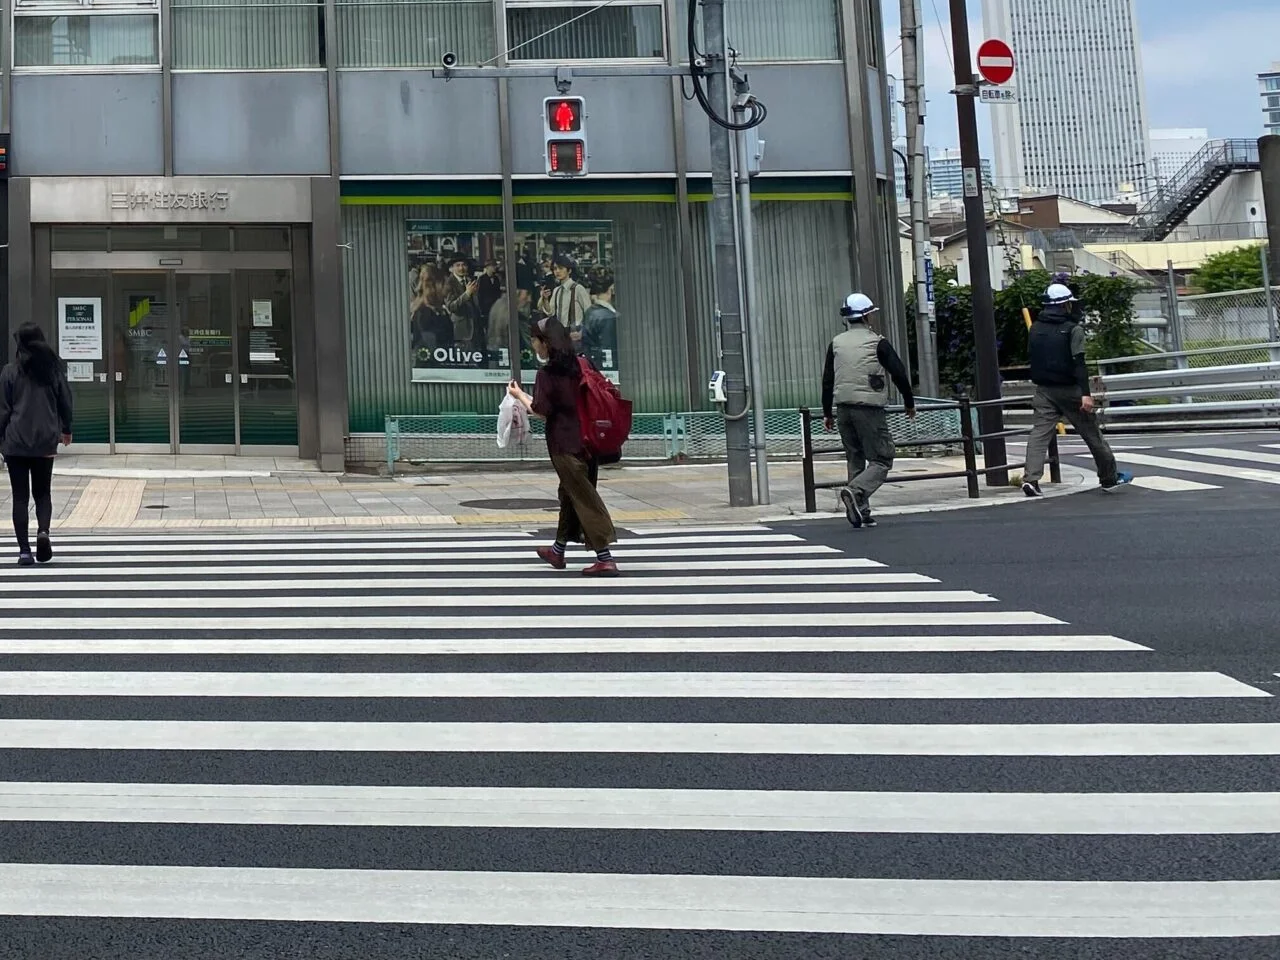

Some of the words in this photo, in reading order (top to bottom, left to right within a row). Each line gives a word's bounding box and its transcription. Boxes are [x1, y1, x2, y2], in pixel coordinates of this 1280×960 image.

[111, 191, 229, 210] 三井住友銀行
[434, 347, 483, 363] Olive
